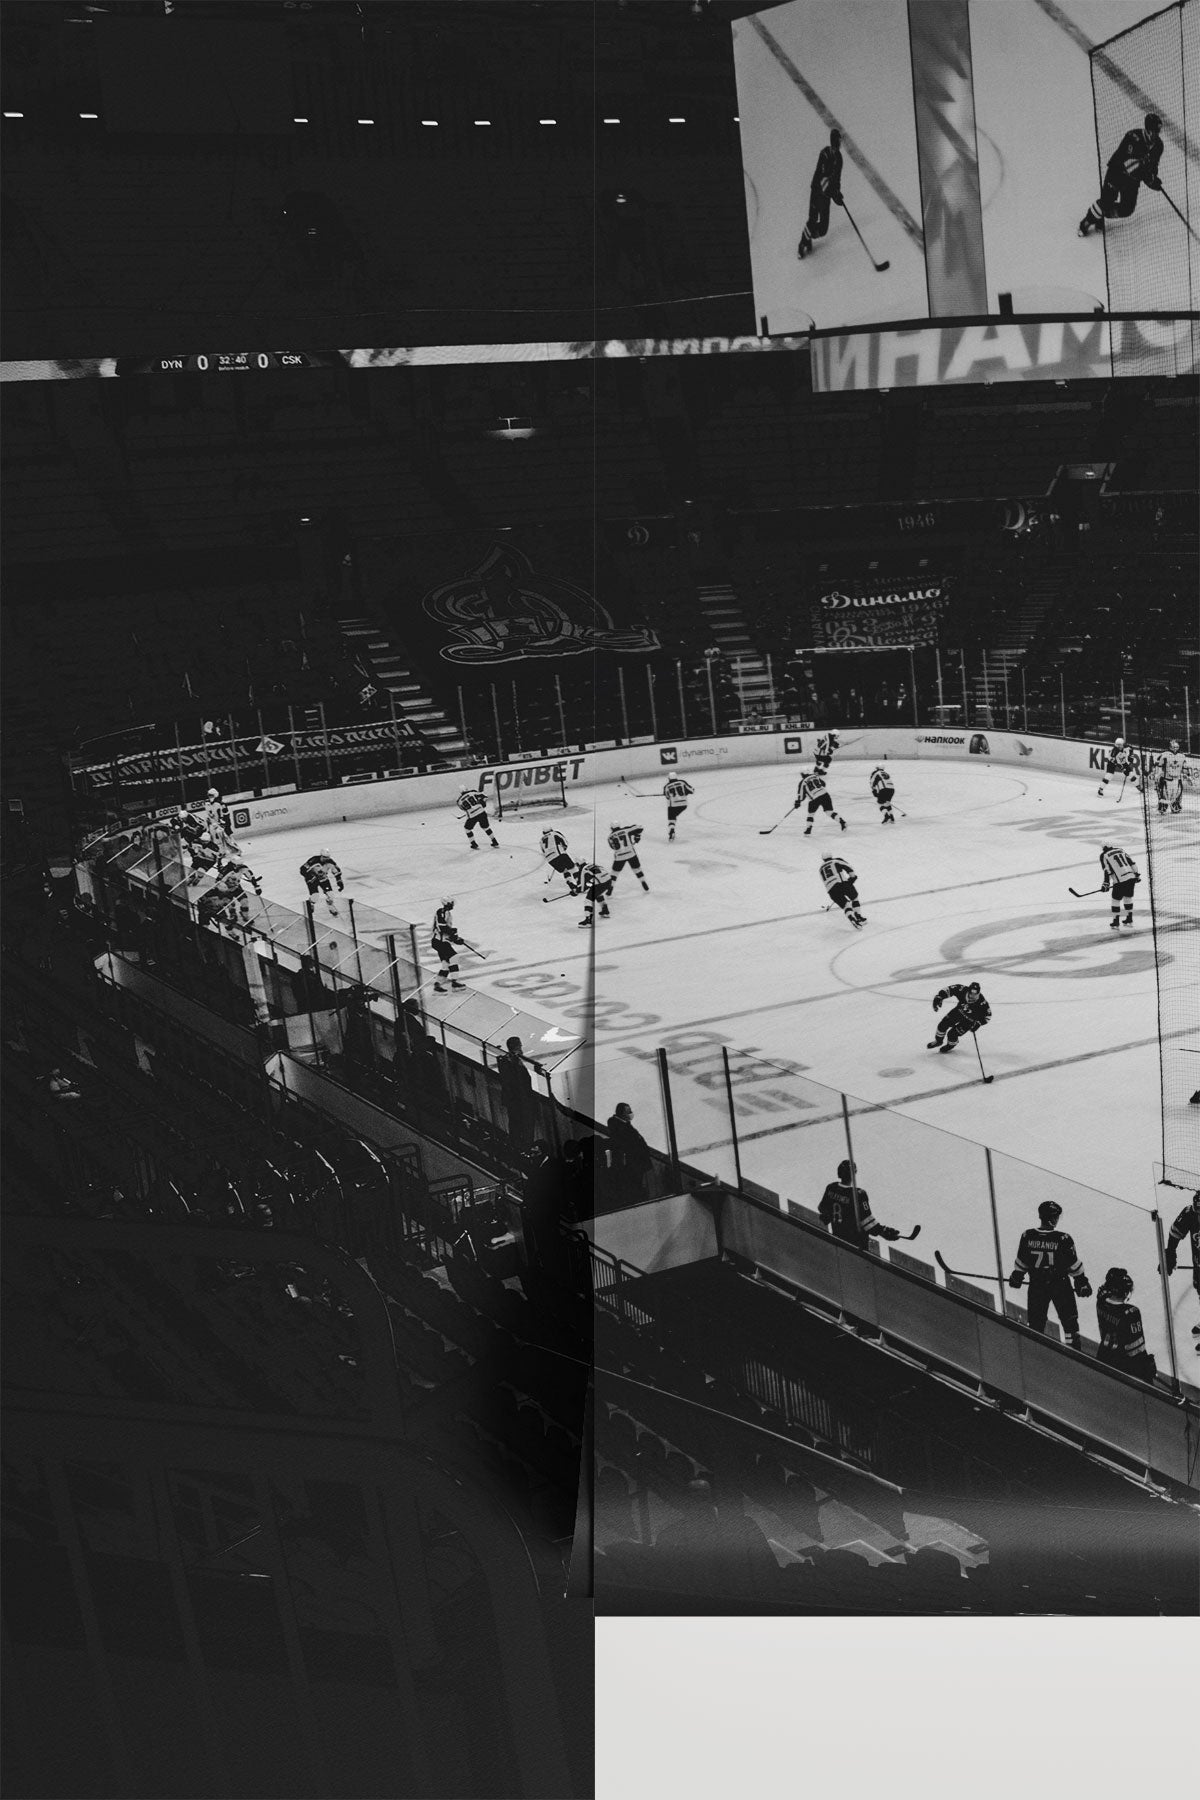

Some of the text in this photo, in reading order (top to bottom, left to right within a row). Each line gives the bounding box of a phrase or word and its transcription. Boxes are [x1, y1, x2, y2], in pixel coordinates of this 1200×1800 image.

[161, 360, 183, 369] DYN
[197, 355, 209, 370] 0
[219, 356, 247, 364] 32:40
[257, 353, 269, 369] 0
[281, 355, 302, 365] CSK
[898, 512, 935, 530] 1946
[820, 588, 941, 609] Динамо
[479, 758, 585, 792] FONBET
[820, 864, 834, 881] 15
[1027, 1240, 1059, 1250] MURANOV
[1030, 1250, 1054, 1269] 71
